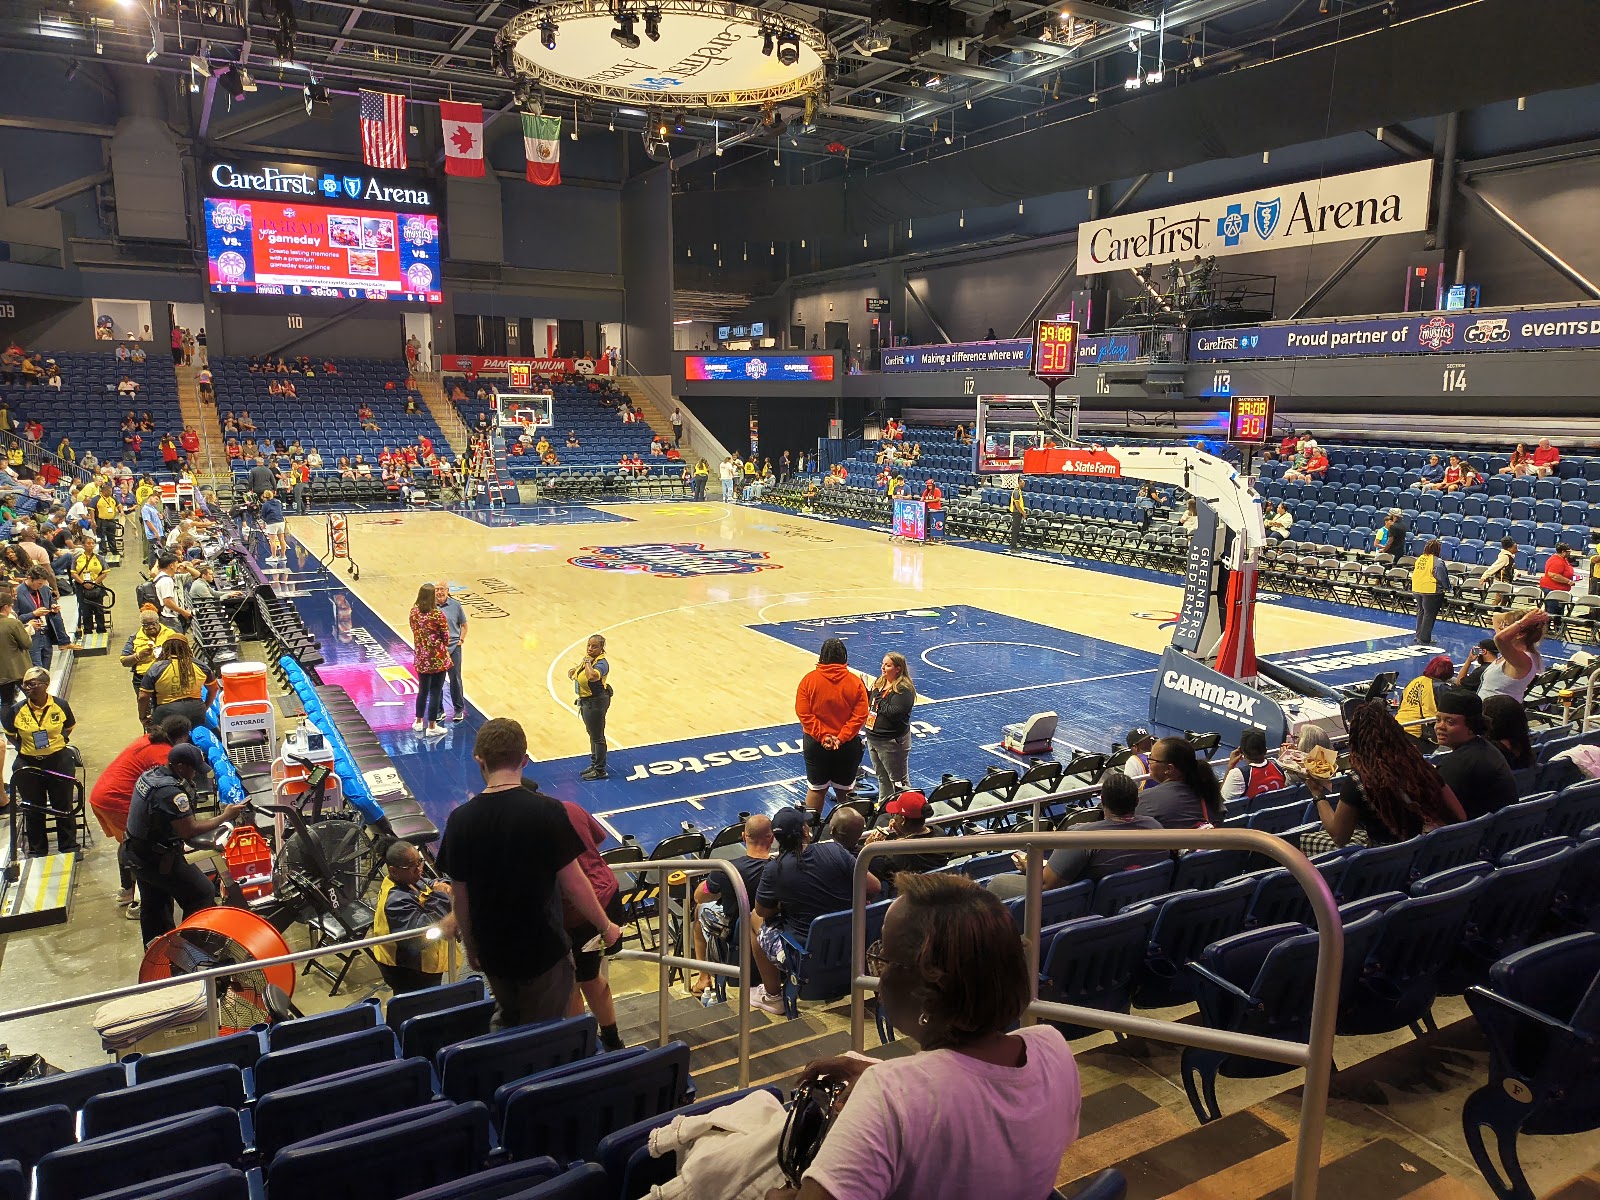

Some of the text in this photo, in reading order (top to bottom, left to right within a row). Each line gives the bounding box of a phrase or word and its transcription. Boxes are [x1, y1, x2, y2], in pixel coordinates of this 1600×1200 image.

[211, 164, 431, 206] CareFirst Arena
[1090, 191, 1403, 264] CareFirst Arena
[268, 235, 320, 247] gameday
[287, 316, 303, 329] 110
[1041, 326, 1072, 342] 39:08
[1287, 326, 1409, 349] Proud partner of
[1080, 344, 1097, 357] and
[1197, 336, 1239, 351] CareFirst
[921, 349, 1024, 366] Making a difference where we
[1043, 343, 1067, 370] 30
[1213, 374, 1231, 393] 113
[1442, 369, 1467, 392] 114
[1238, 401, 1267, 416] 39:08
[1241, 417, 1260, 436] 30
[1073, 460, 1116, 474] State Farm
[1177, 553, 1200, 637] BEDERMAN
[1187, 547, 1210, 639] GREENBERG
[230, 718, 265, 727] GATORADE
[624, 720, 943, 782] timaster
[245, 863, 257, 875] G
[1512, 1083, 1524, 1096] F
